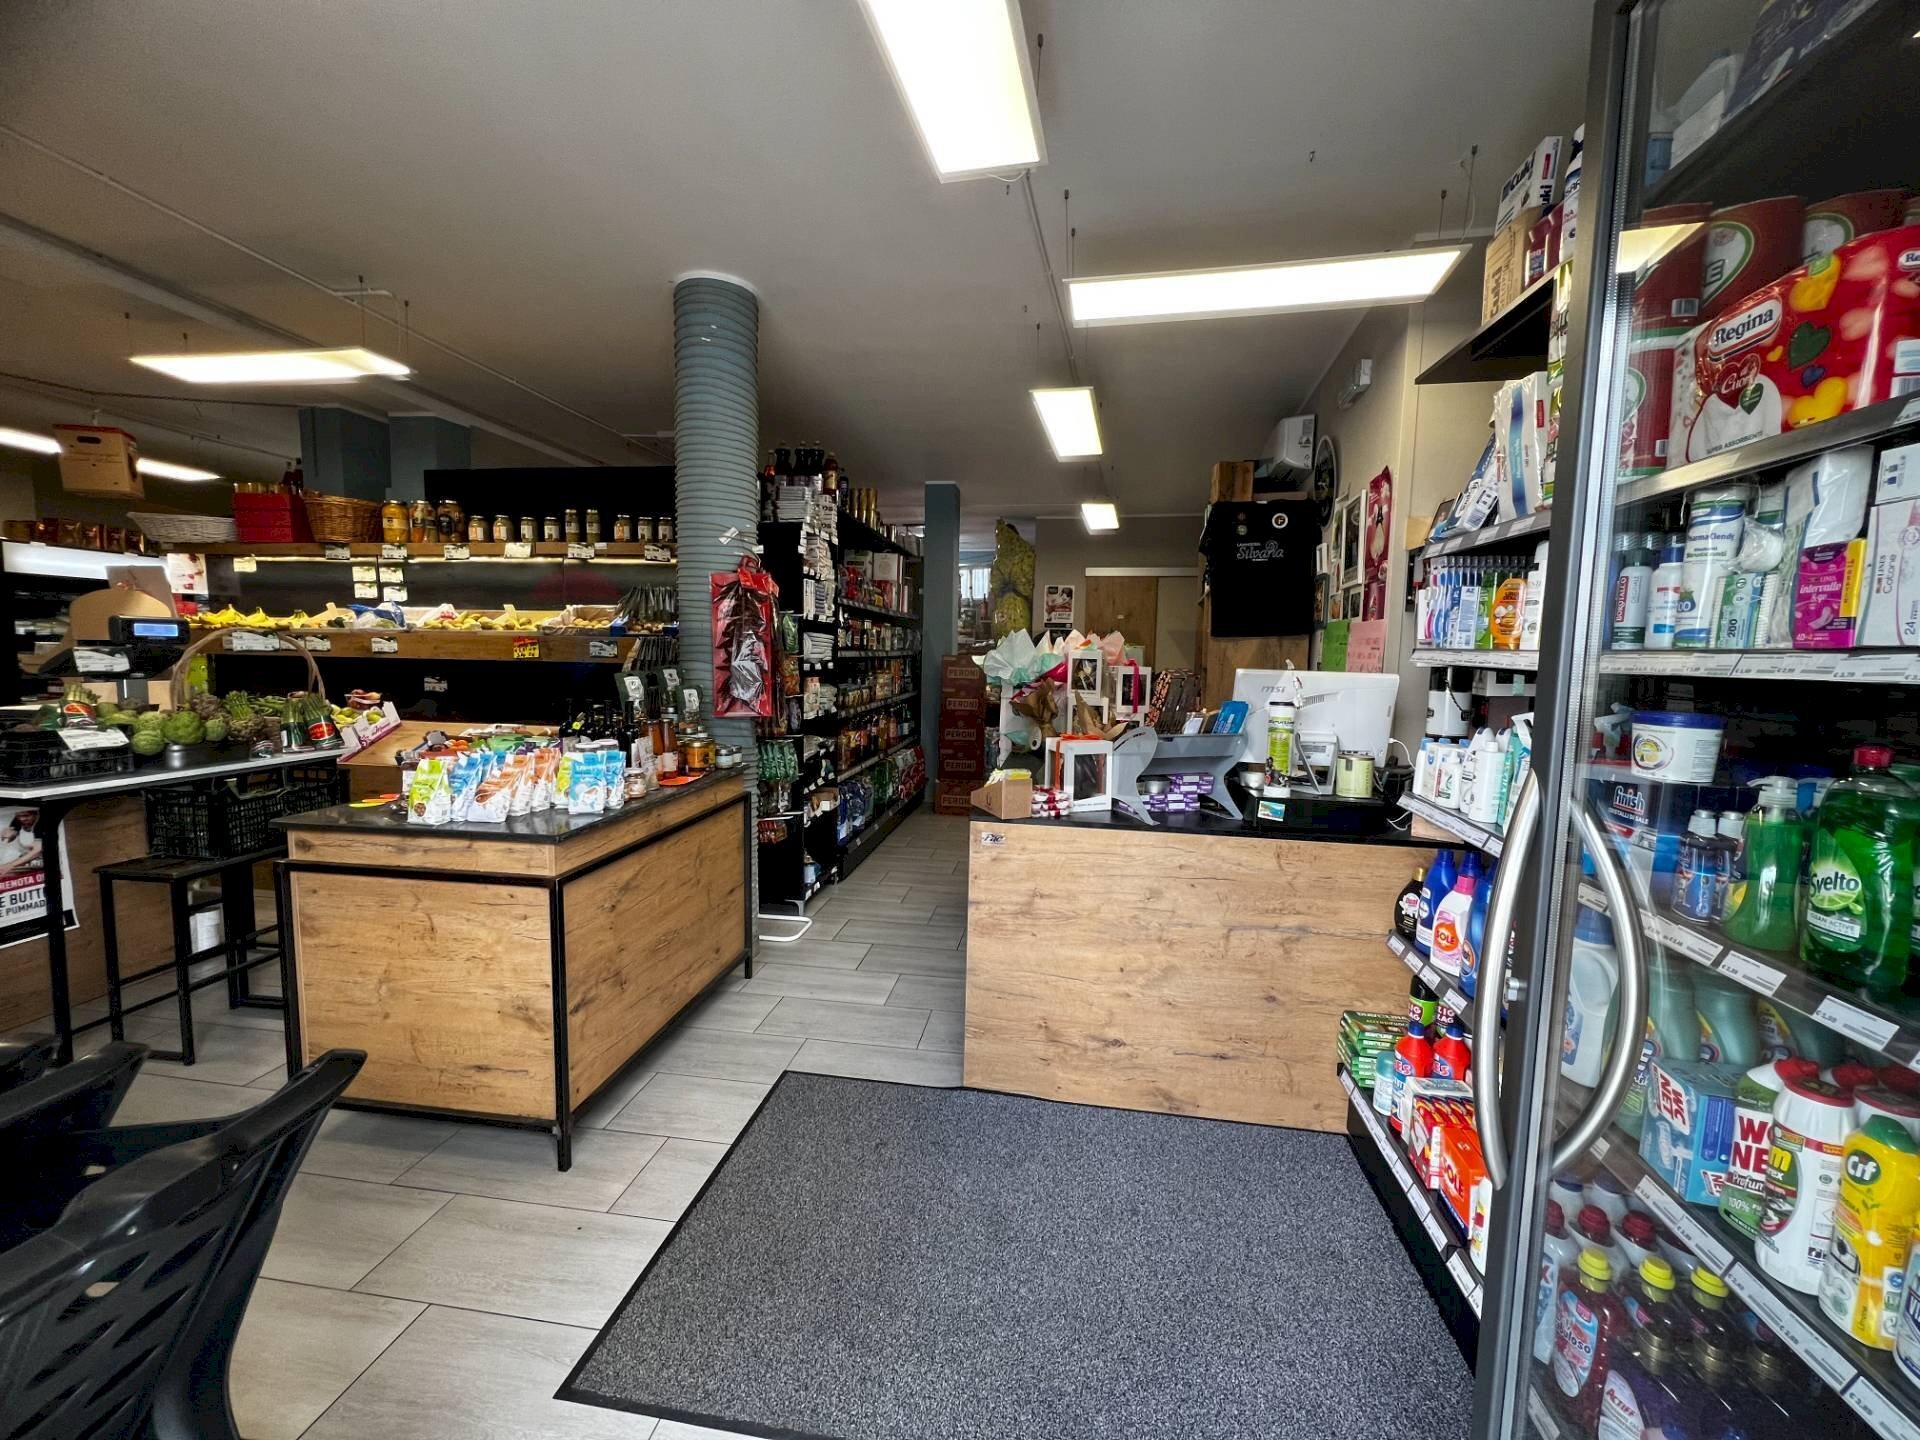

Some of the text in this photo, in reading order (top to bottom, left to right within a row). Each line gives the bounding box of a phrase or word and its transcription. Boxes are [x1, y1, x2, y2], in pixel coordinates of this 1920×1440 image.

[1714, 309, 1773, 347] Regina
[1237, 546, 1284, 560] Silvana
[1882, 554, 1897, 594] Cotone
[1615, 577, 1627, 621] BOROTALCO
[1678, 602, 1691, 611] 00
[1727, 618, 1738, 638] 200
[1904, 620, 1916, 635] 24
[1261, 685, 1286, 693] msi
[946, 730, 975, 739] PERONI
[946, 761, 975, 770] PERONI
[1614, 786, 1645, 812] finish
[0, 876, 34, 889] RENOTA
[1810, 871, 1860, 898] Svelto
[10, 889, 45, 906] BUTT
[1436, 929, 1455, 945] SOLE
[1659, 1072, 1675, 1121] NET
[1671, 1088, 1687, 1127] WC
[1738, 1115, 1769, 1145] W
[1731, 1141, 1769, 1175] NE
[1847, 1154, 1878, 1181] Cif
[1728, 1196, 1751, 1213] 100%
